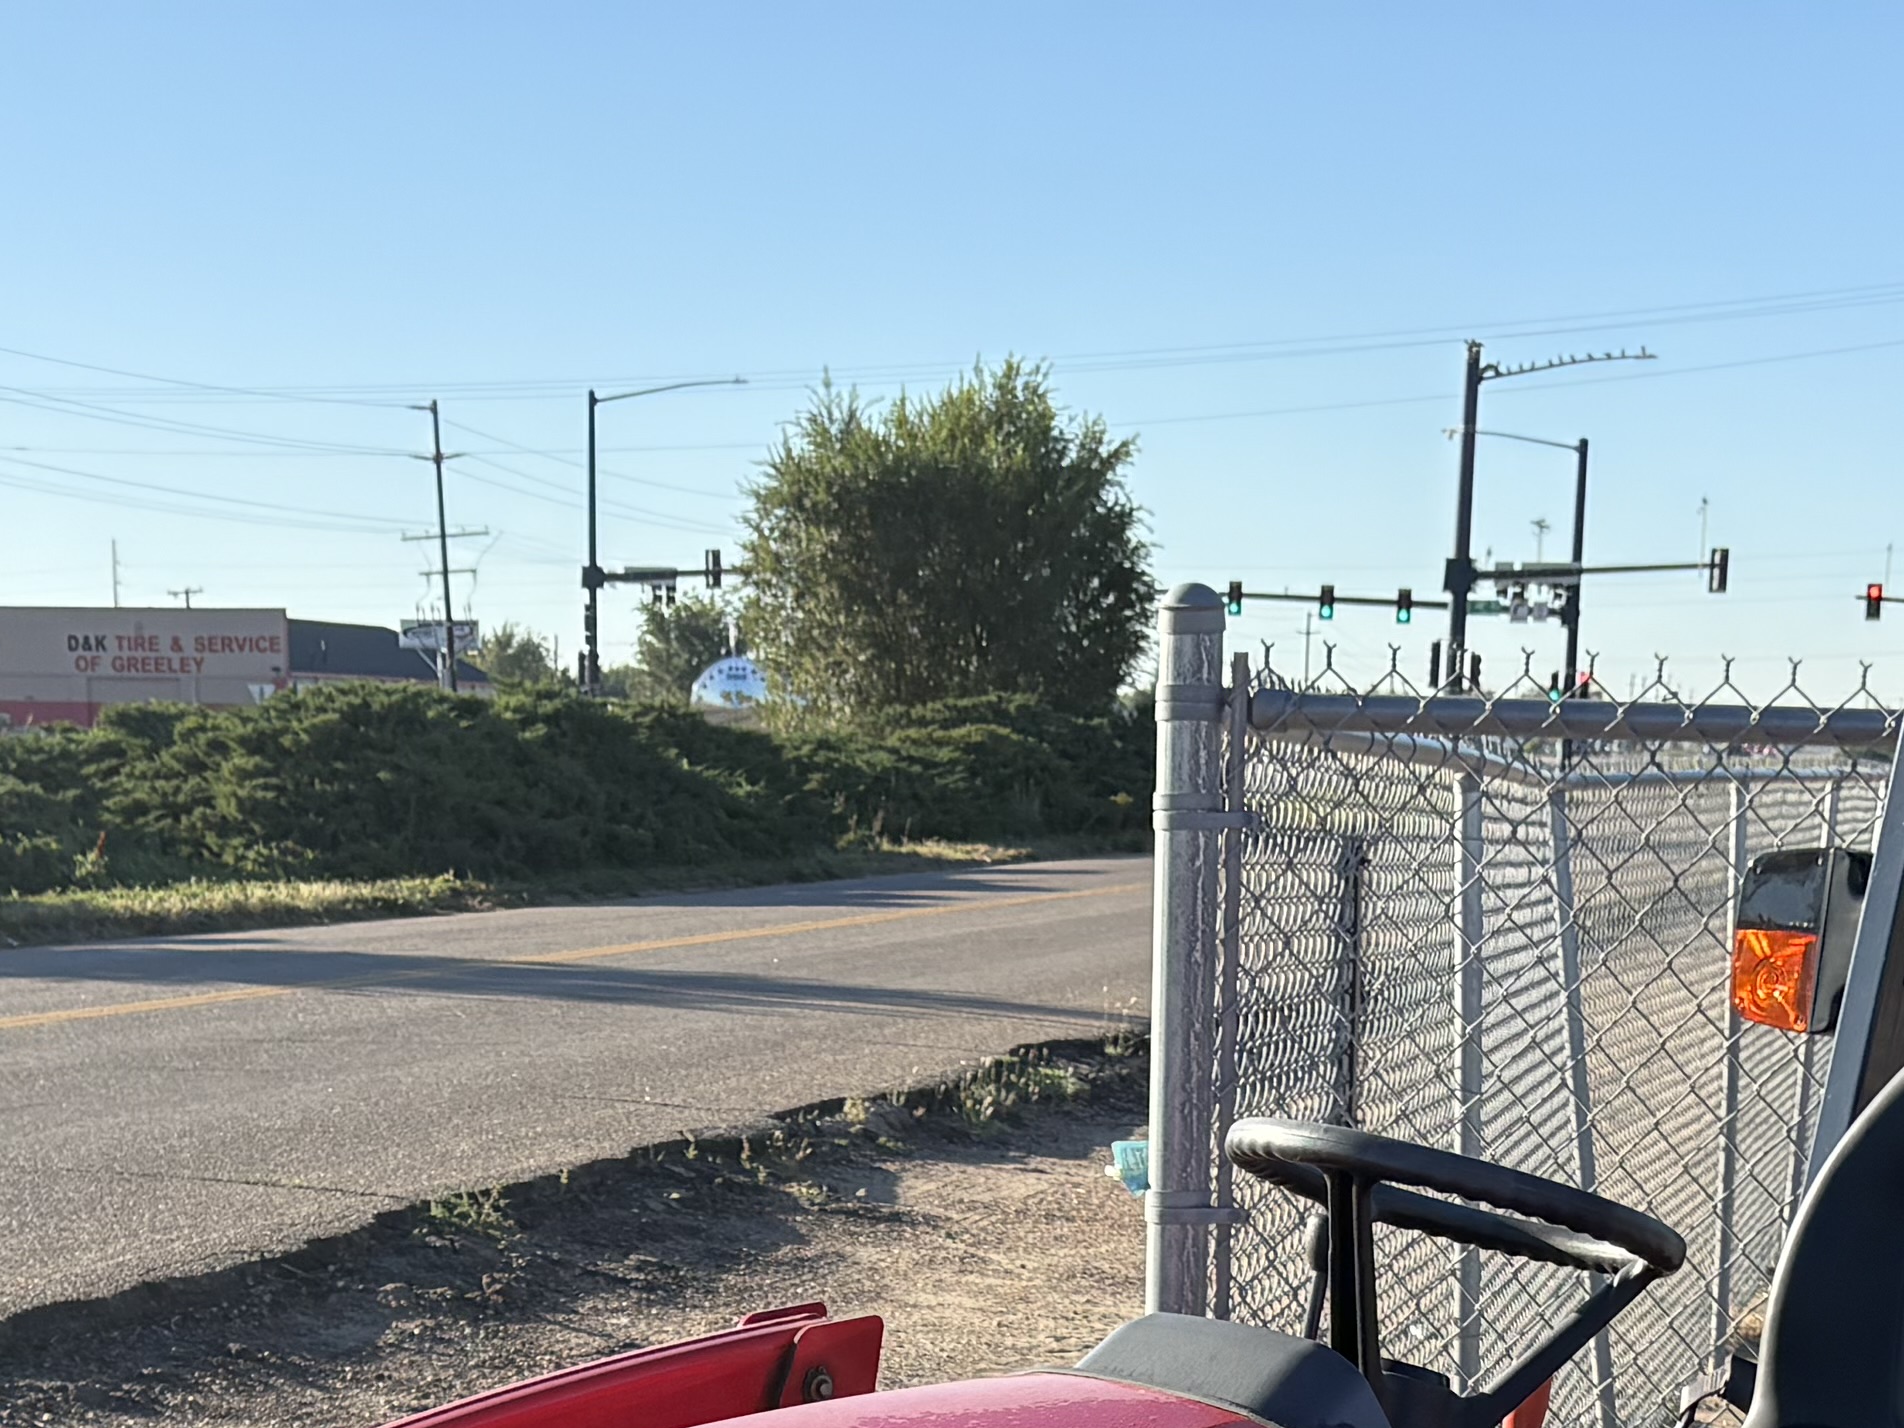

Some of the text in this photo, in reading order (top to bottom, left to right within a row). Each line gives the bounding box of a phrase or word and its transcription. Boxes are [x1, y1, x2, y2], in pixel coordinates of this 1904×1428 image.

[67, 634, 281, 653] D&K TIRE & SERVICE
[74, 655, 205, 673] OF GREELEY
